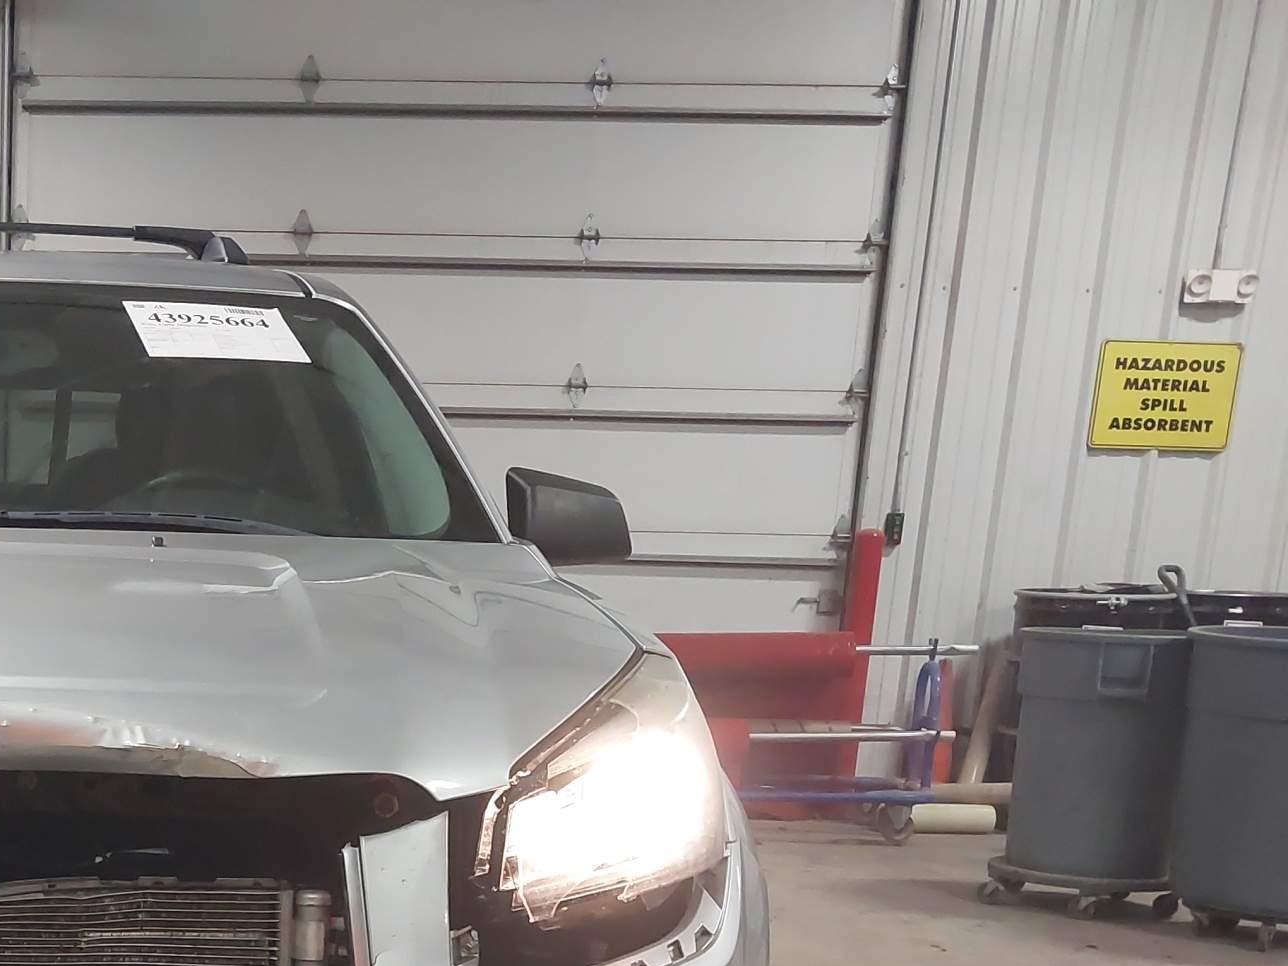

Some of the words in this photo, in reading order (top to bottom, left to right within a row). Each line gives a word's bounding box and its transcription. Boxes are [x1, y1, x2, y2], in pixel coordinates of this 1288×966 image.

[147, 312, 270, 329] 43925664
[1115, 357, 1226, 373] HAZARDOUS
[1123, 377, 1210, 393] MATERIAL
[1139, 398, 1188, 412] SPILL
[1108, 417, 1214, 433] ABSORBENT
